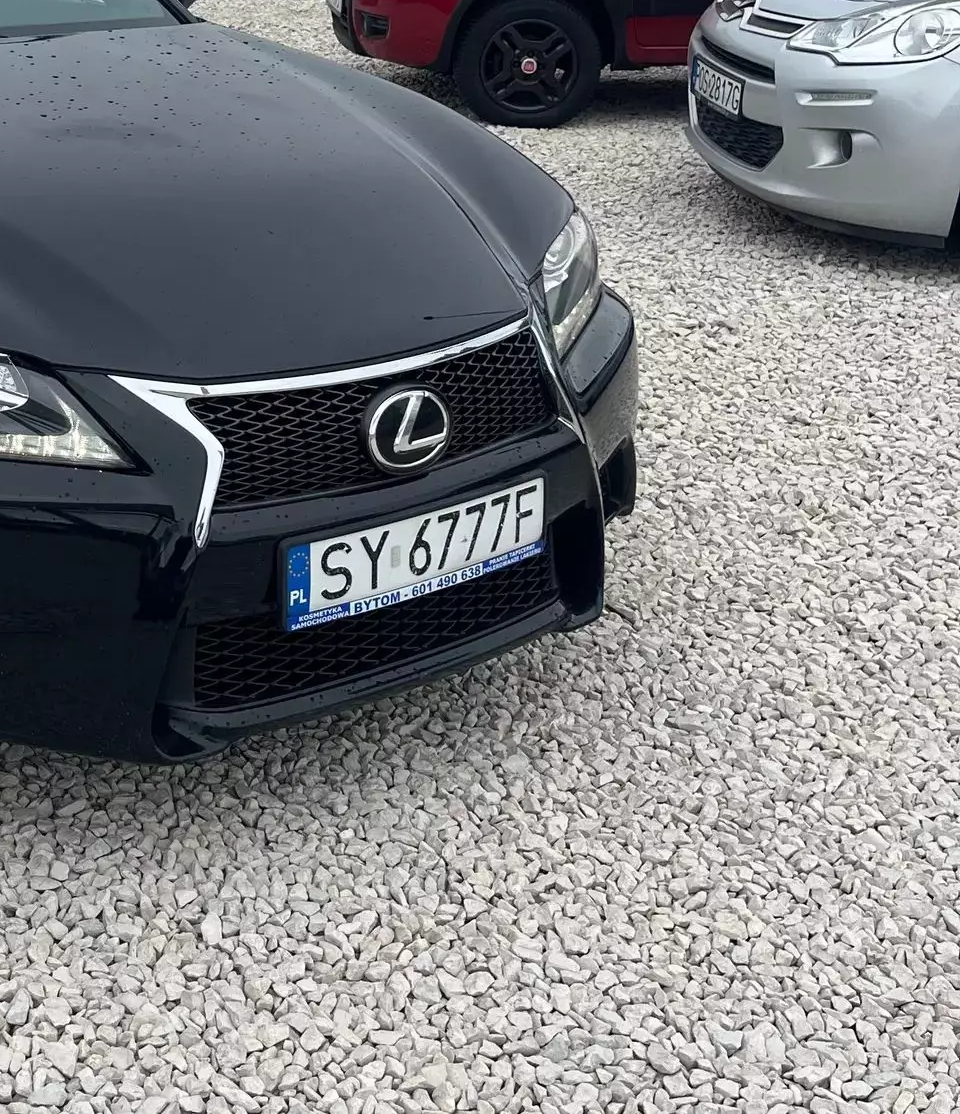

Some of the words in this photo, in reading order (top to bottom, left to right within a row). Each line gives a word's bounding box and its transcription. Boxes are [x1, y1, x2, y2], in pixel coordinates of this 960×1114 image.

[709, 73, 740, 111] 2817G
[320, 529, 390, 601] SY
[408, 484, 538, 577] 6777F
[290, 588, 308, 606] PL
[354, 591, 401, 614] BYTOM
[411, 581, 432, 597] 601
[436, 573, 458, 588] 490
[461, 565, 481, 581] 638
[291, 610, 350, 631] SAMOCHODOWA
[298, 605, 343, 622] KOSMETYKA
